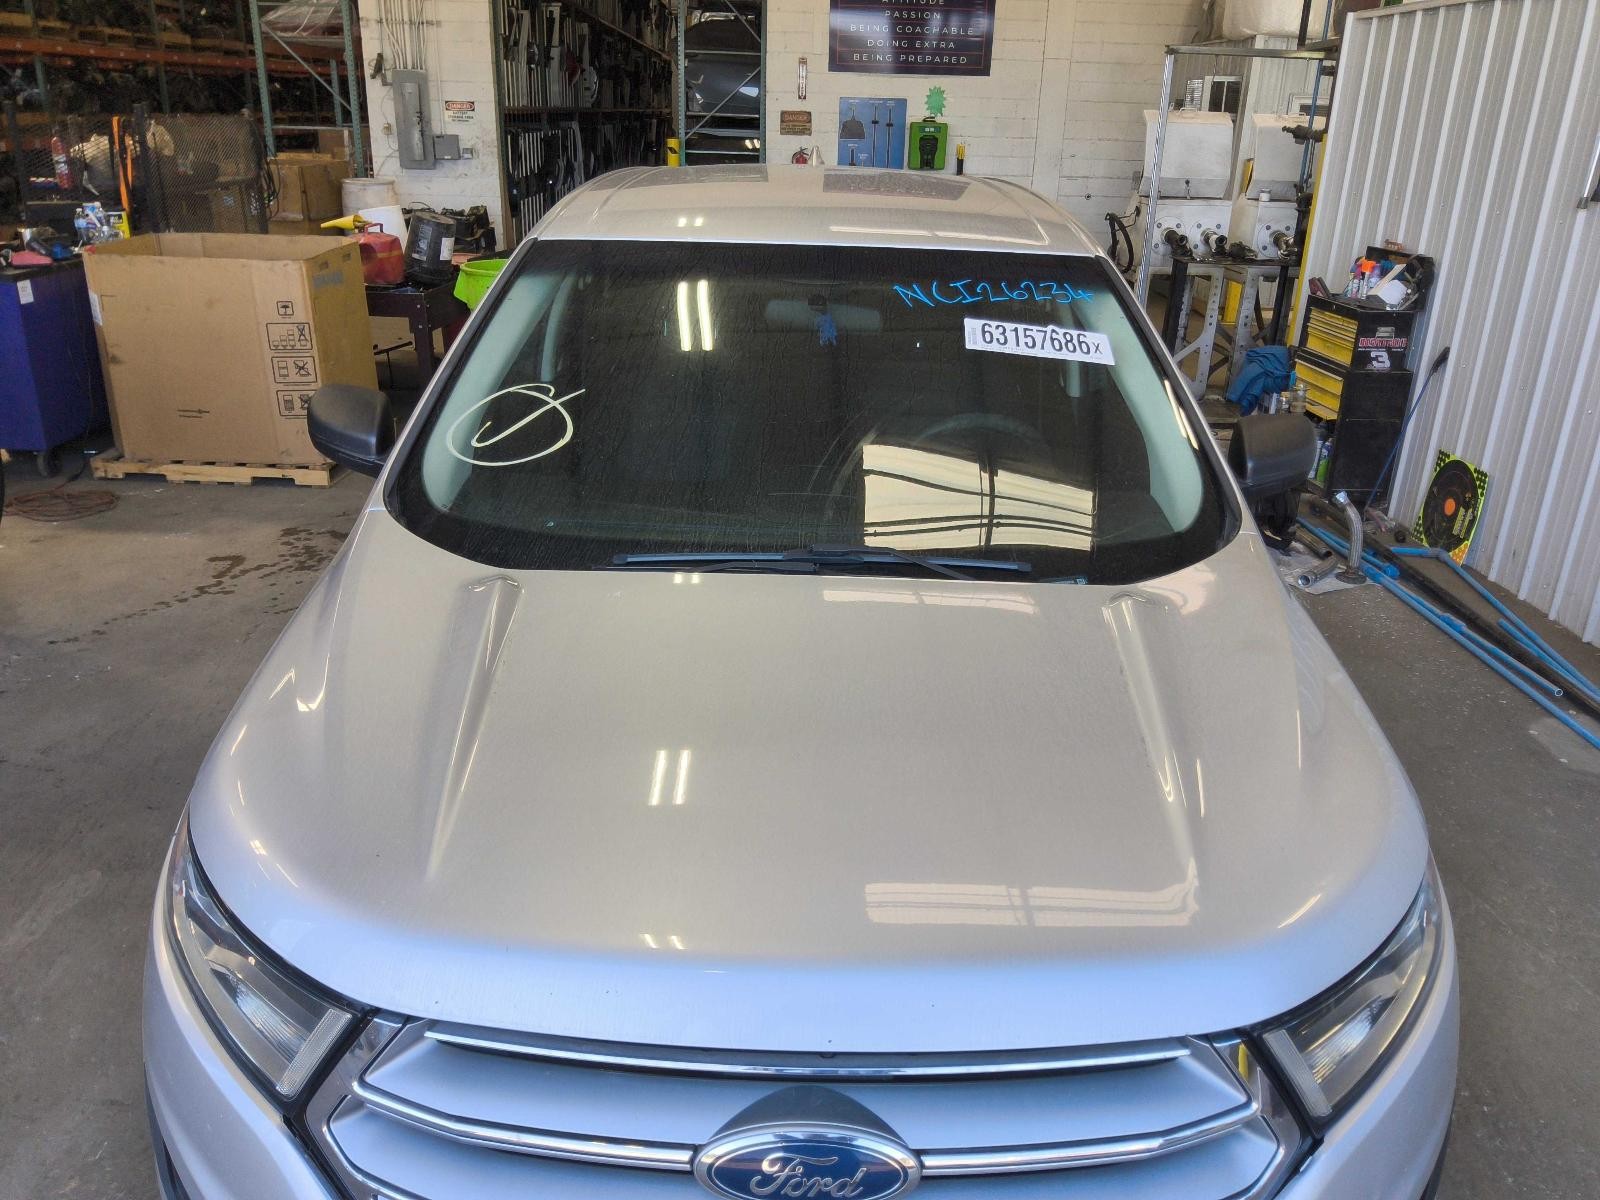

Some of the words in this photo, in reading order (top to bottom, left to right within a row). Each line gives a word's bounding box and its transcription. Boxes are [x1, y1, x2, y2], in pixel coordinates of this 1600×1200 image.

[884, 10, 941, 19] PASSION
[850, 24, 890, 32] BEING
[896, 25, 974, 35] COACHABLE
[867, 39, 908, 48] DOING
[915, 40, 955, 49] EXTRA
[853, 53, 893, 62] BEING
[900, 54, 967, 64] PREPARED
[1370, 351, 1391, 369] 3
[750, 1152, 867, 1198] Ford
